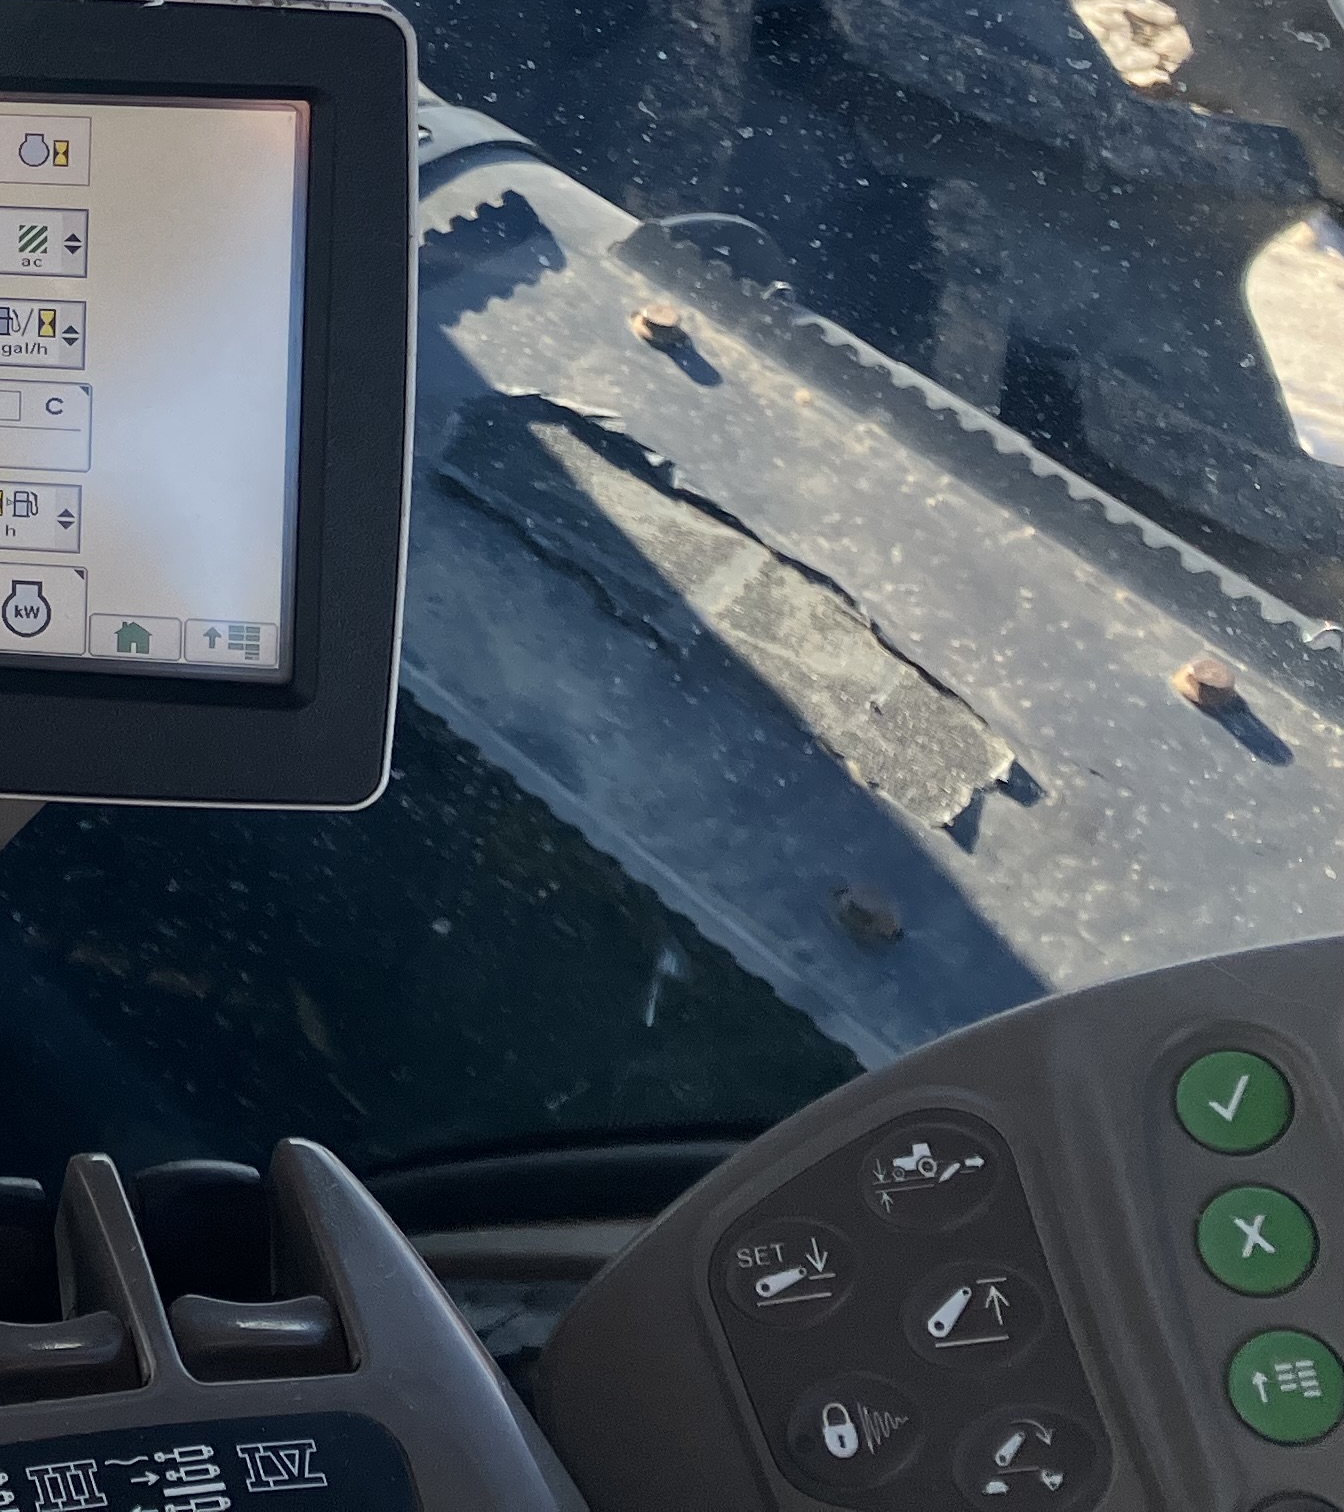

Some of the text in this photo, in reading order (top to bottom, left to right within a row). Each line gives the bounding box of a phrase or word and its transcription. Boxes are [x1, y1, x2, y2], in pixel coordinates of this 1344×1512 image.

[20, 256, 44, 269] ac
[44, 396, 65, 416] C
[5, 523, 16, 538] h
[14, 604, 41, 620] kW
[736, 1242, 785, 1269] SET
[26, 1439, 328, 1512] III IV
